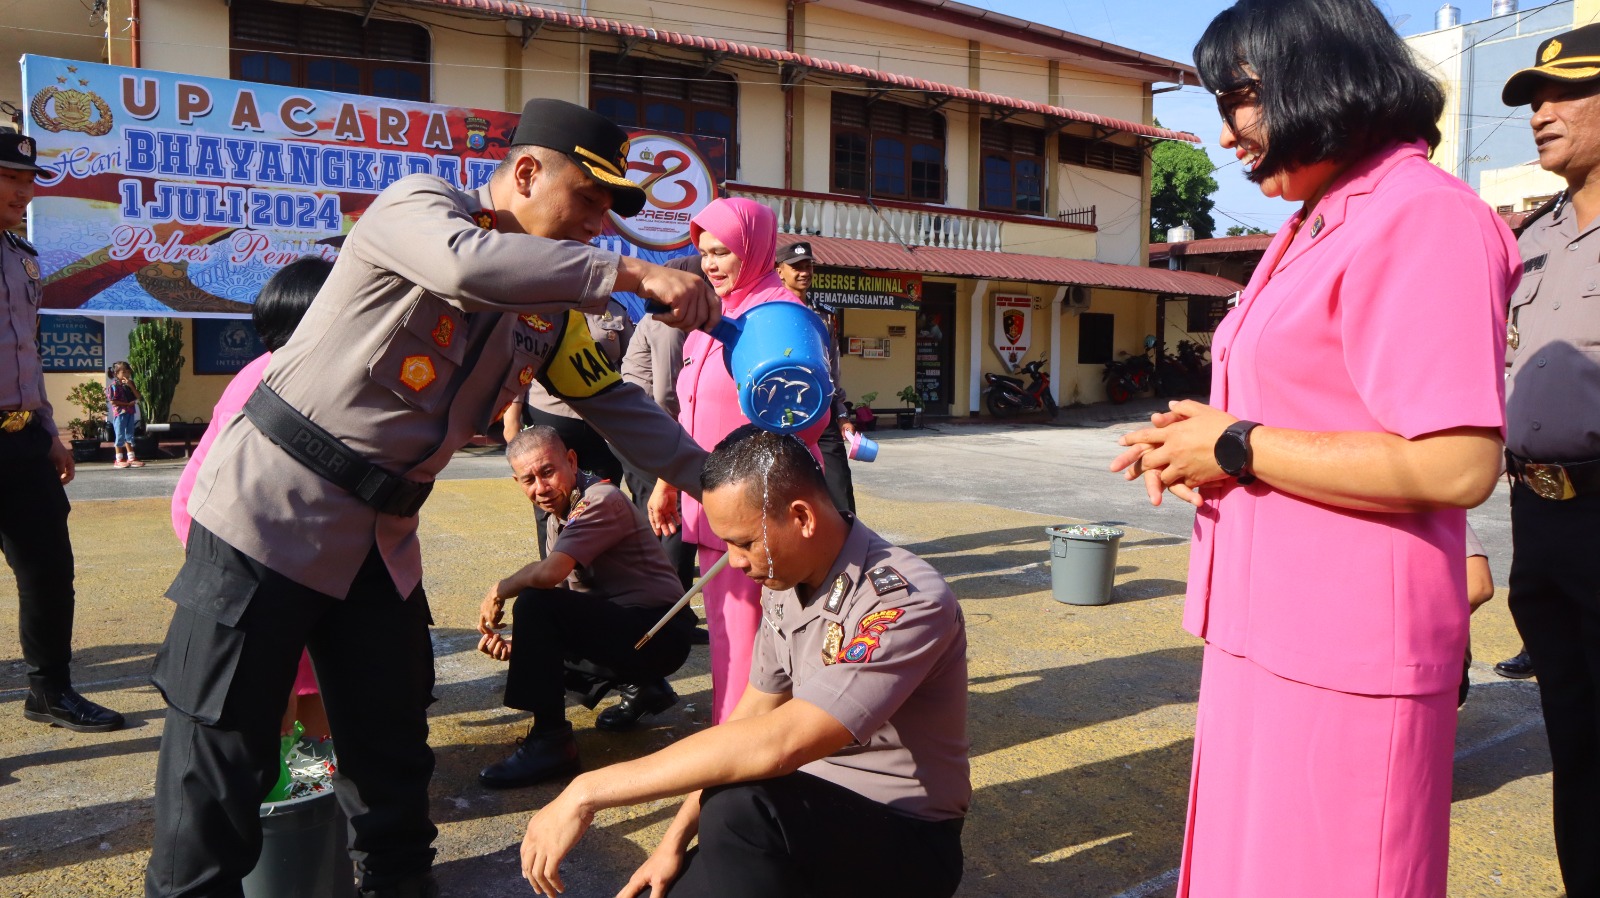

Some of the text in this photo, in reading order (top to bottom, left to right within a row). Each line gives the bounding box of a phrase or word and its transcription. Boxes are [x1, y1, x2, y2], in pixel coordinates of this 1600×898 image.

[120, 76, 453, 149] UPACARA
[36, 147, 121, 185] Hari
[121, 181, 341, 231] 1 JULI 2024
[635, 209, 692, 222] PRESISI
[110, 225, 209, 263] Polres
[811, 273, 903, 293] RESERSE KRIMINAL
[814, 292, 895, 306] PEMATANGSIANTAR
[41, 332, 102, 344] TURN
[41, 358, 103, 367] CRIME
[292, 427, 350, 475] POLRI
